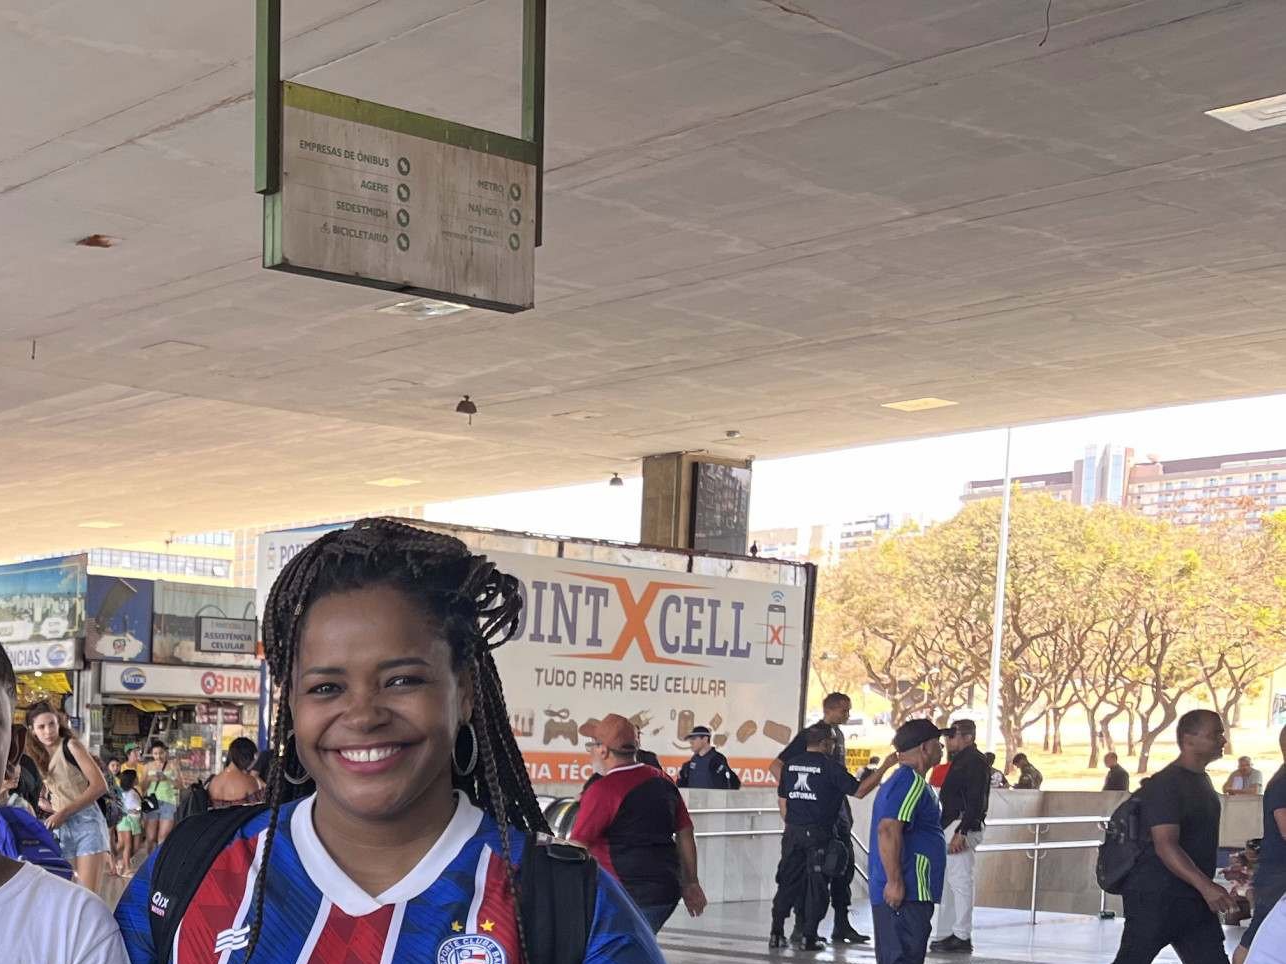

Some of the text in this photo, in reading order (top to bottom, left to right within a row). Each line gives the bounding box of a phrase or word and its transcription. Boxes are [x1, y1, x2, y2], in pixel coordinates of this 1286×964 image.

[299, 139, 342, 158] EMPRESAS
[344, 149, 355, 160] DE
[211, 642, 245, 650] CELULAR
[535, 667, 727, 697] TUDO PARA SEU CELULAR
[462, 938, 495, 951] CLUBE
